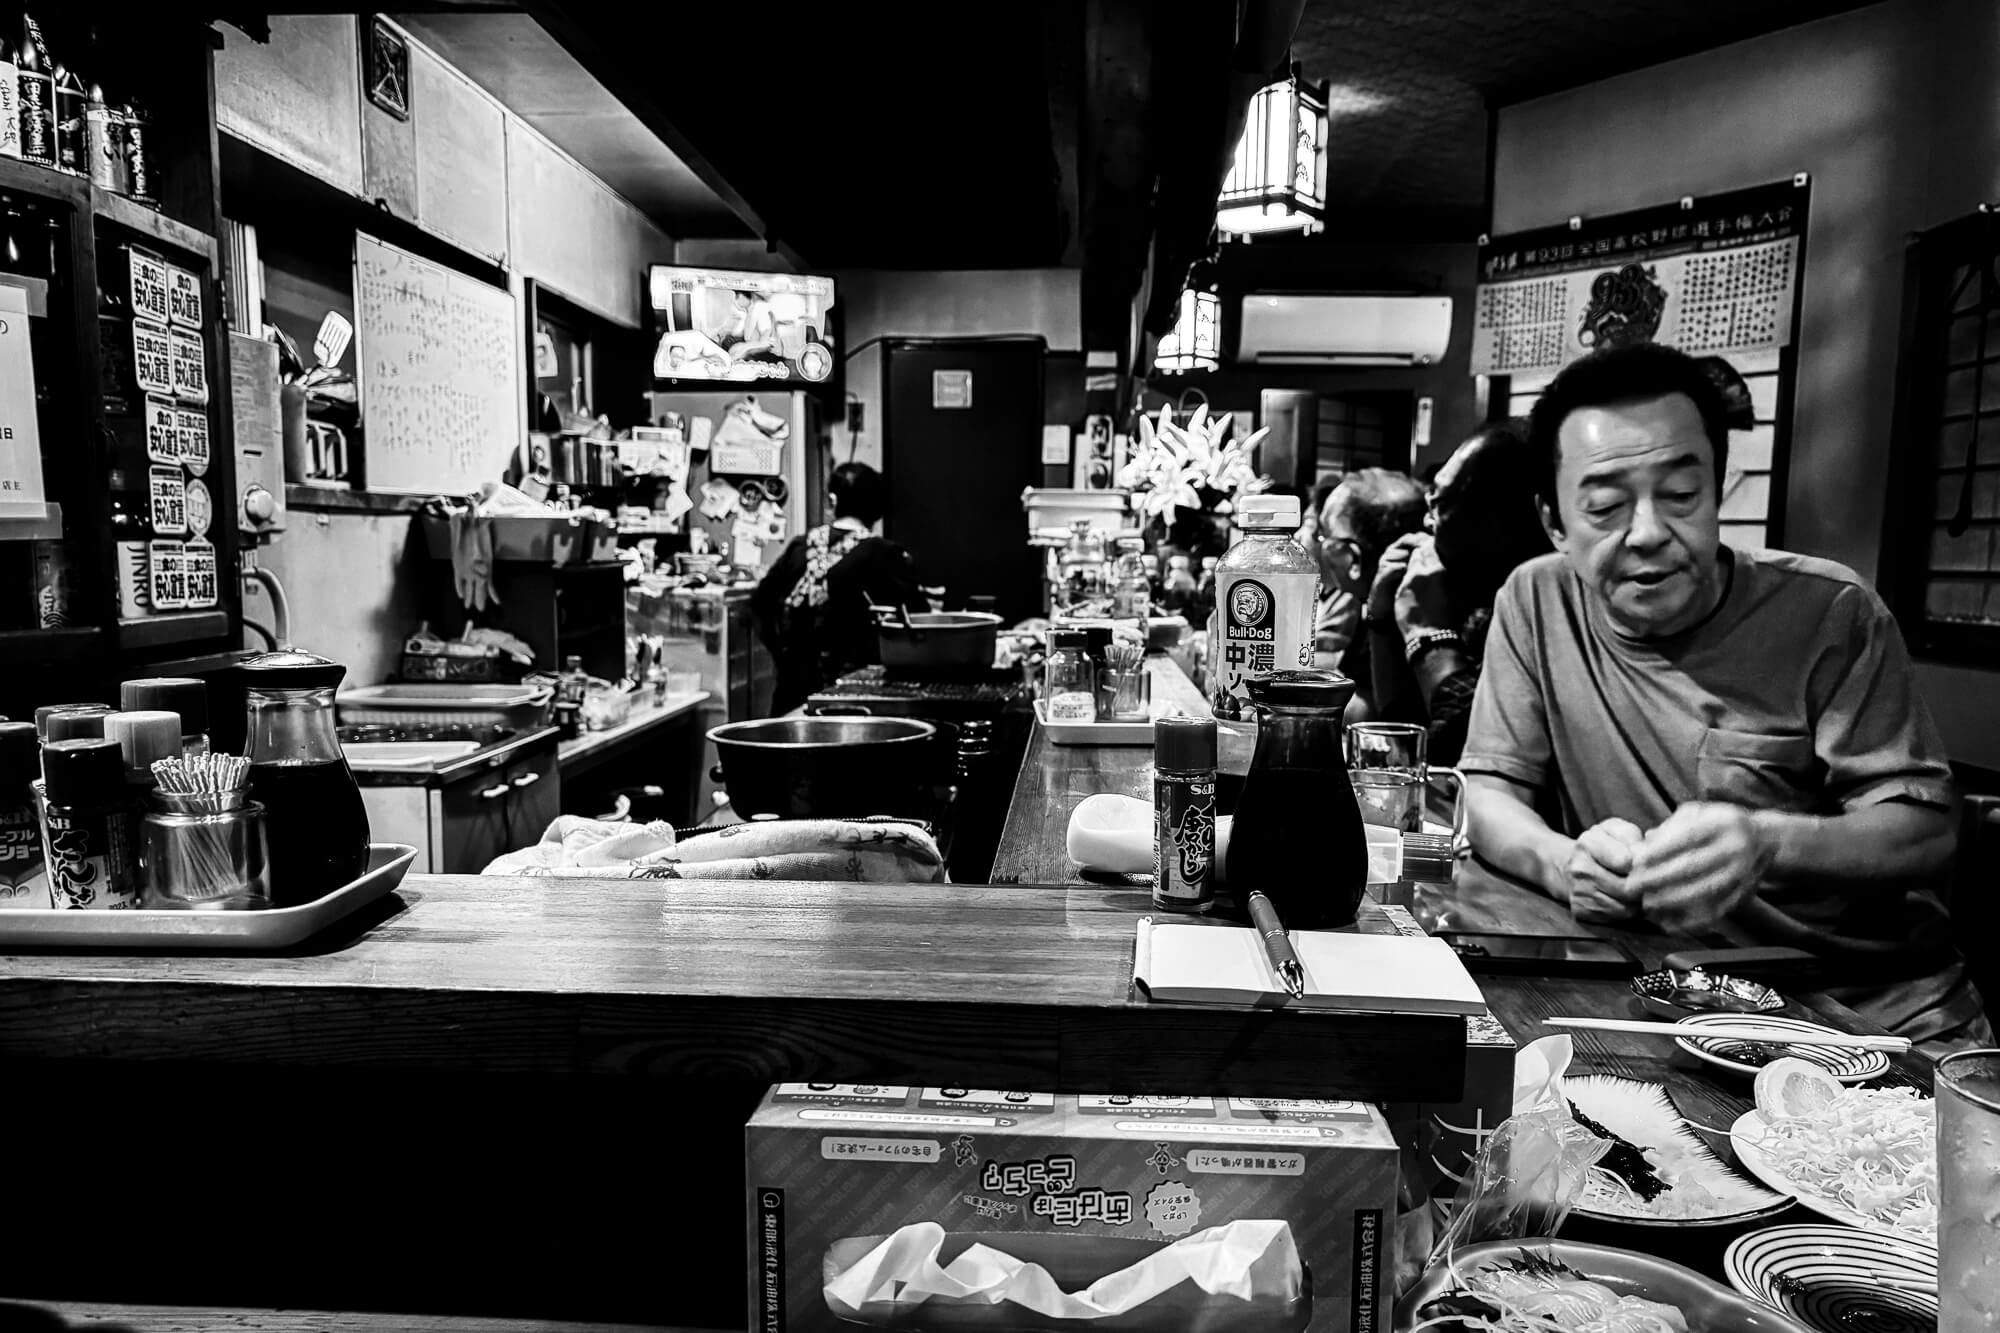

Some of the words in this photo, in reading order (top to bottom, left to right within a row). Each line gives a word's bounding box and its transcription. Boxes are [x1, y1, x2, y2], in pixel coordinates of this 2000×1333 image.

[1225, 642, 1276, 672] 中濃
[1190, 784, 1215, 795] S&B
[983, 1158, 1076, 1195] どっち？
[1032, 1190, 1132, 1226] あなたは
[1359, 1213, 1375, 1333] 液化石油株式会社
